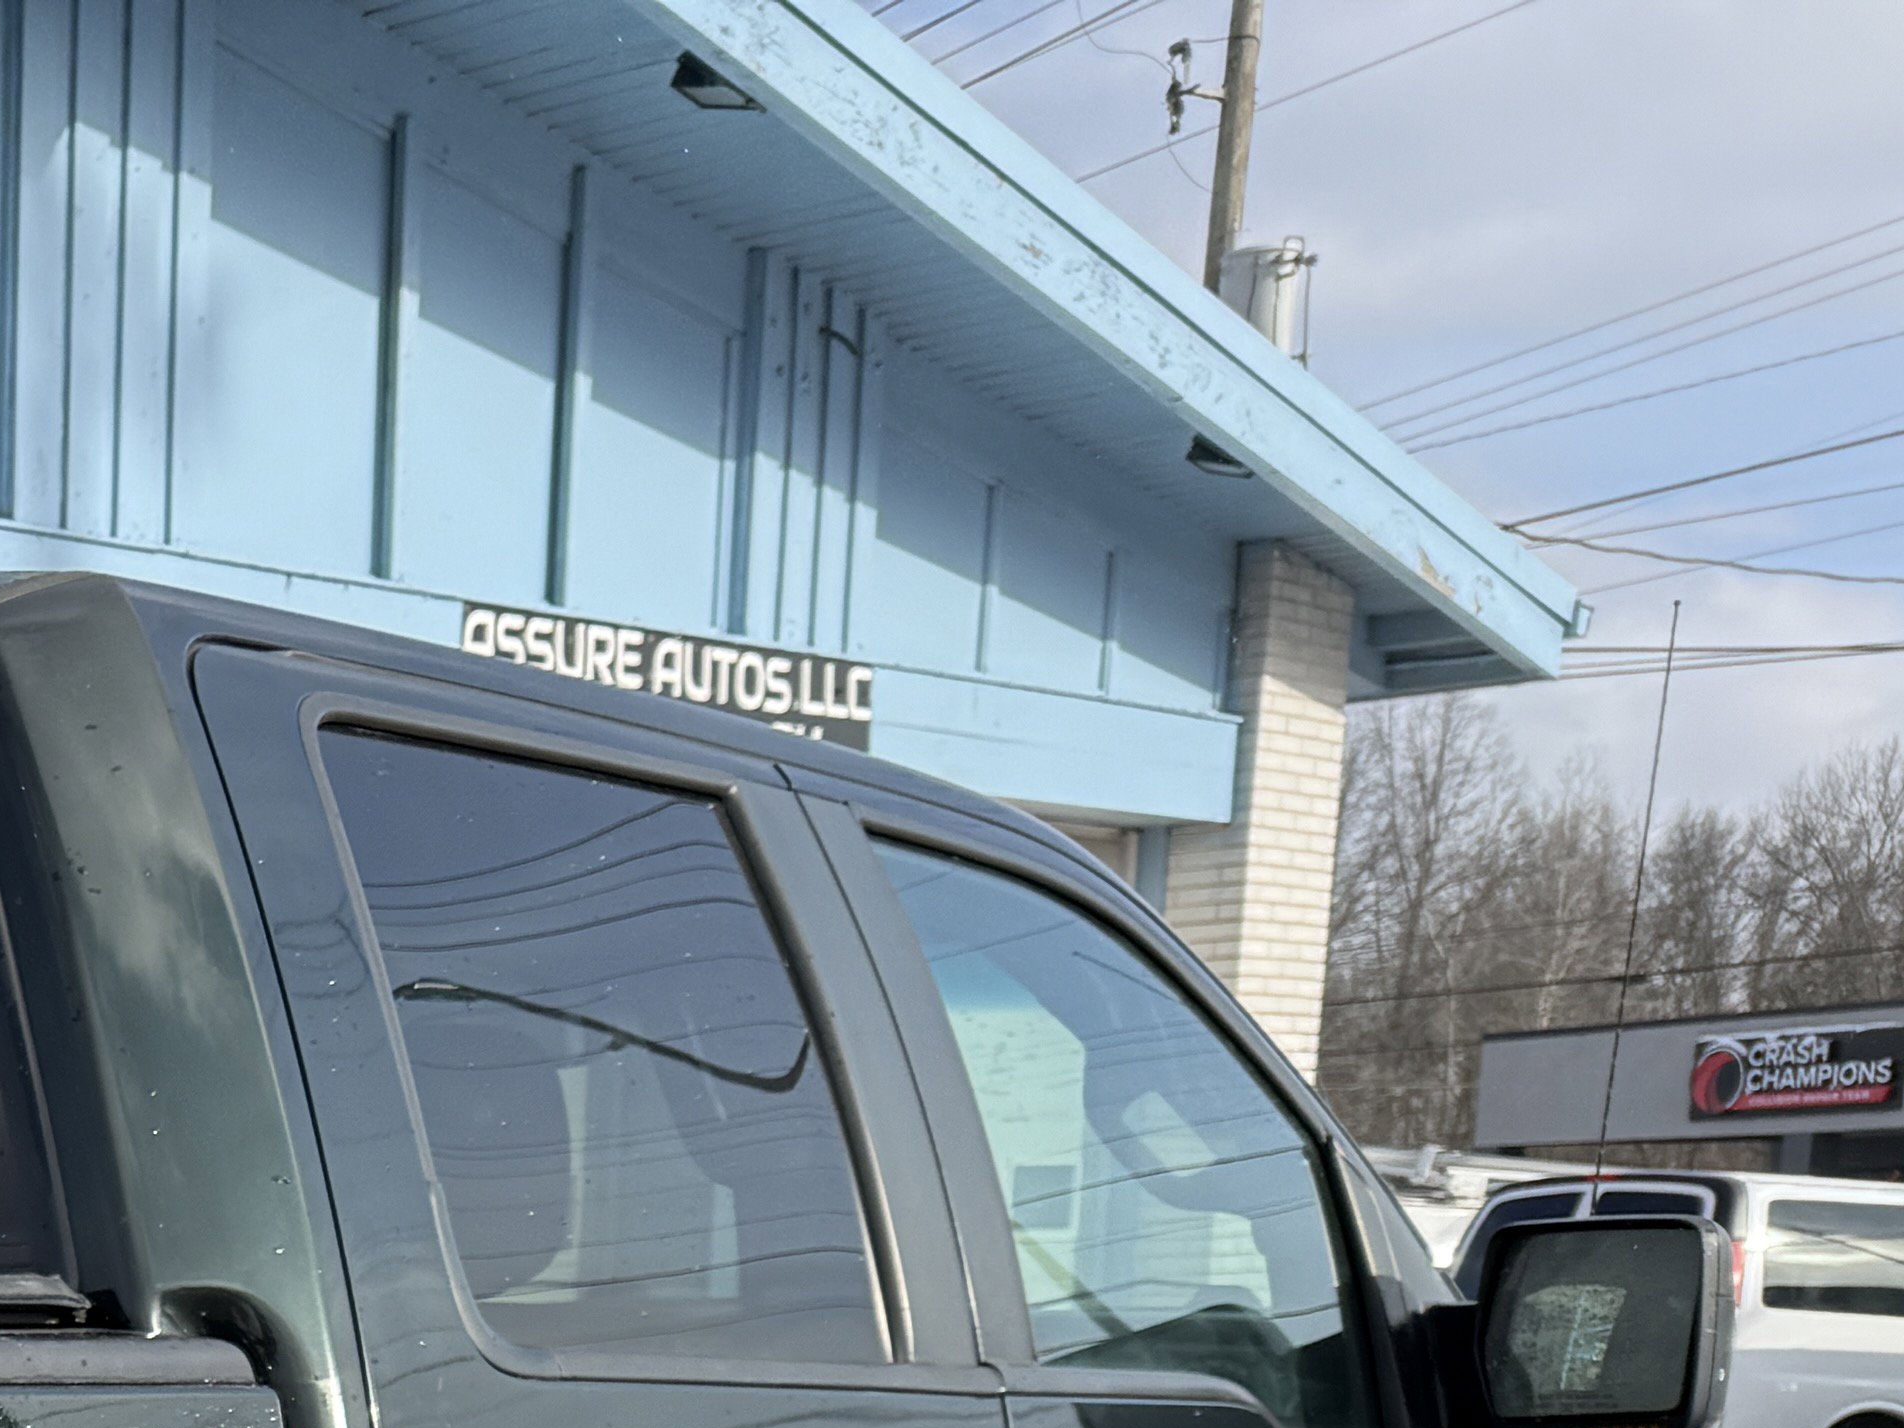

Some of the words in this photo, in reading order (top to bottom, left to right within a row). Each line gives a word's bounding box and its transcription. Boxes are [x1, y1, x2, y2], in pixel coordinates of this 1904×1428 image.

[463, 608, 645, 691] ASSURE
[651, 637, 792, 715] AUTOS
[799, 658, 873, 721] LLC
[1748, 1035, 1832, 1067] CRASH
[1745, 1057, 1892, 1093] CHAMPIONS
